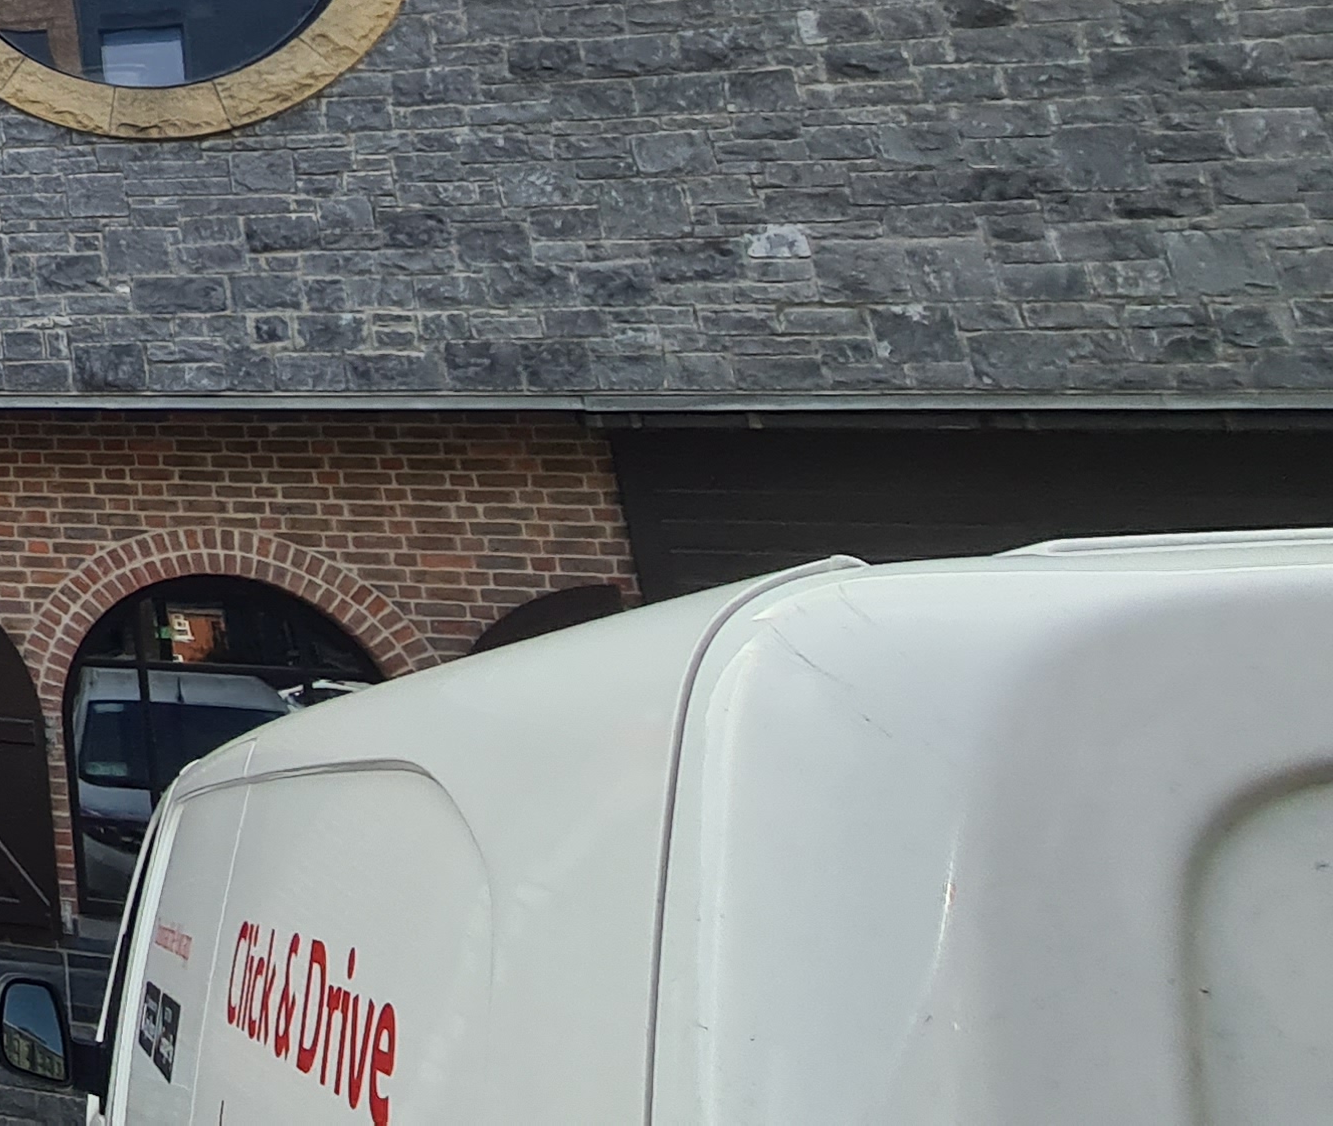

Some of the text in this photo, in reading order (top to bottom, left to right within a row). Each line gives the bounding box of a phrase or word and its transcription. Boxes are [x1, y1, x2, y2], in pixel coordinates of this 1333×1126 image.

[227, 921, 276, 1046] Click
[274, 932, 300, 1061] &
[296, 939, 396, 1126] Drive
